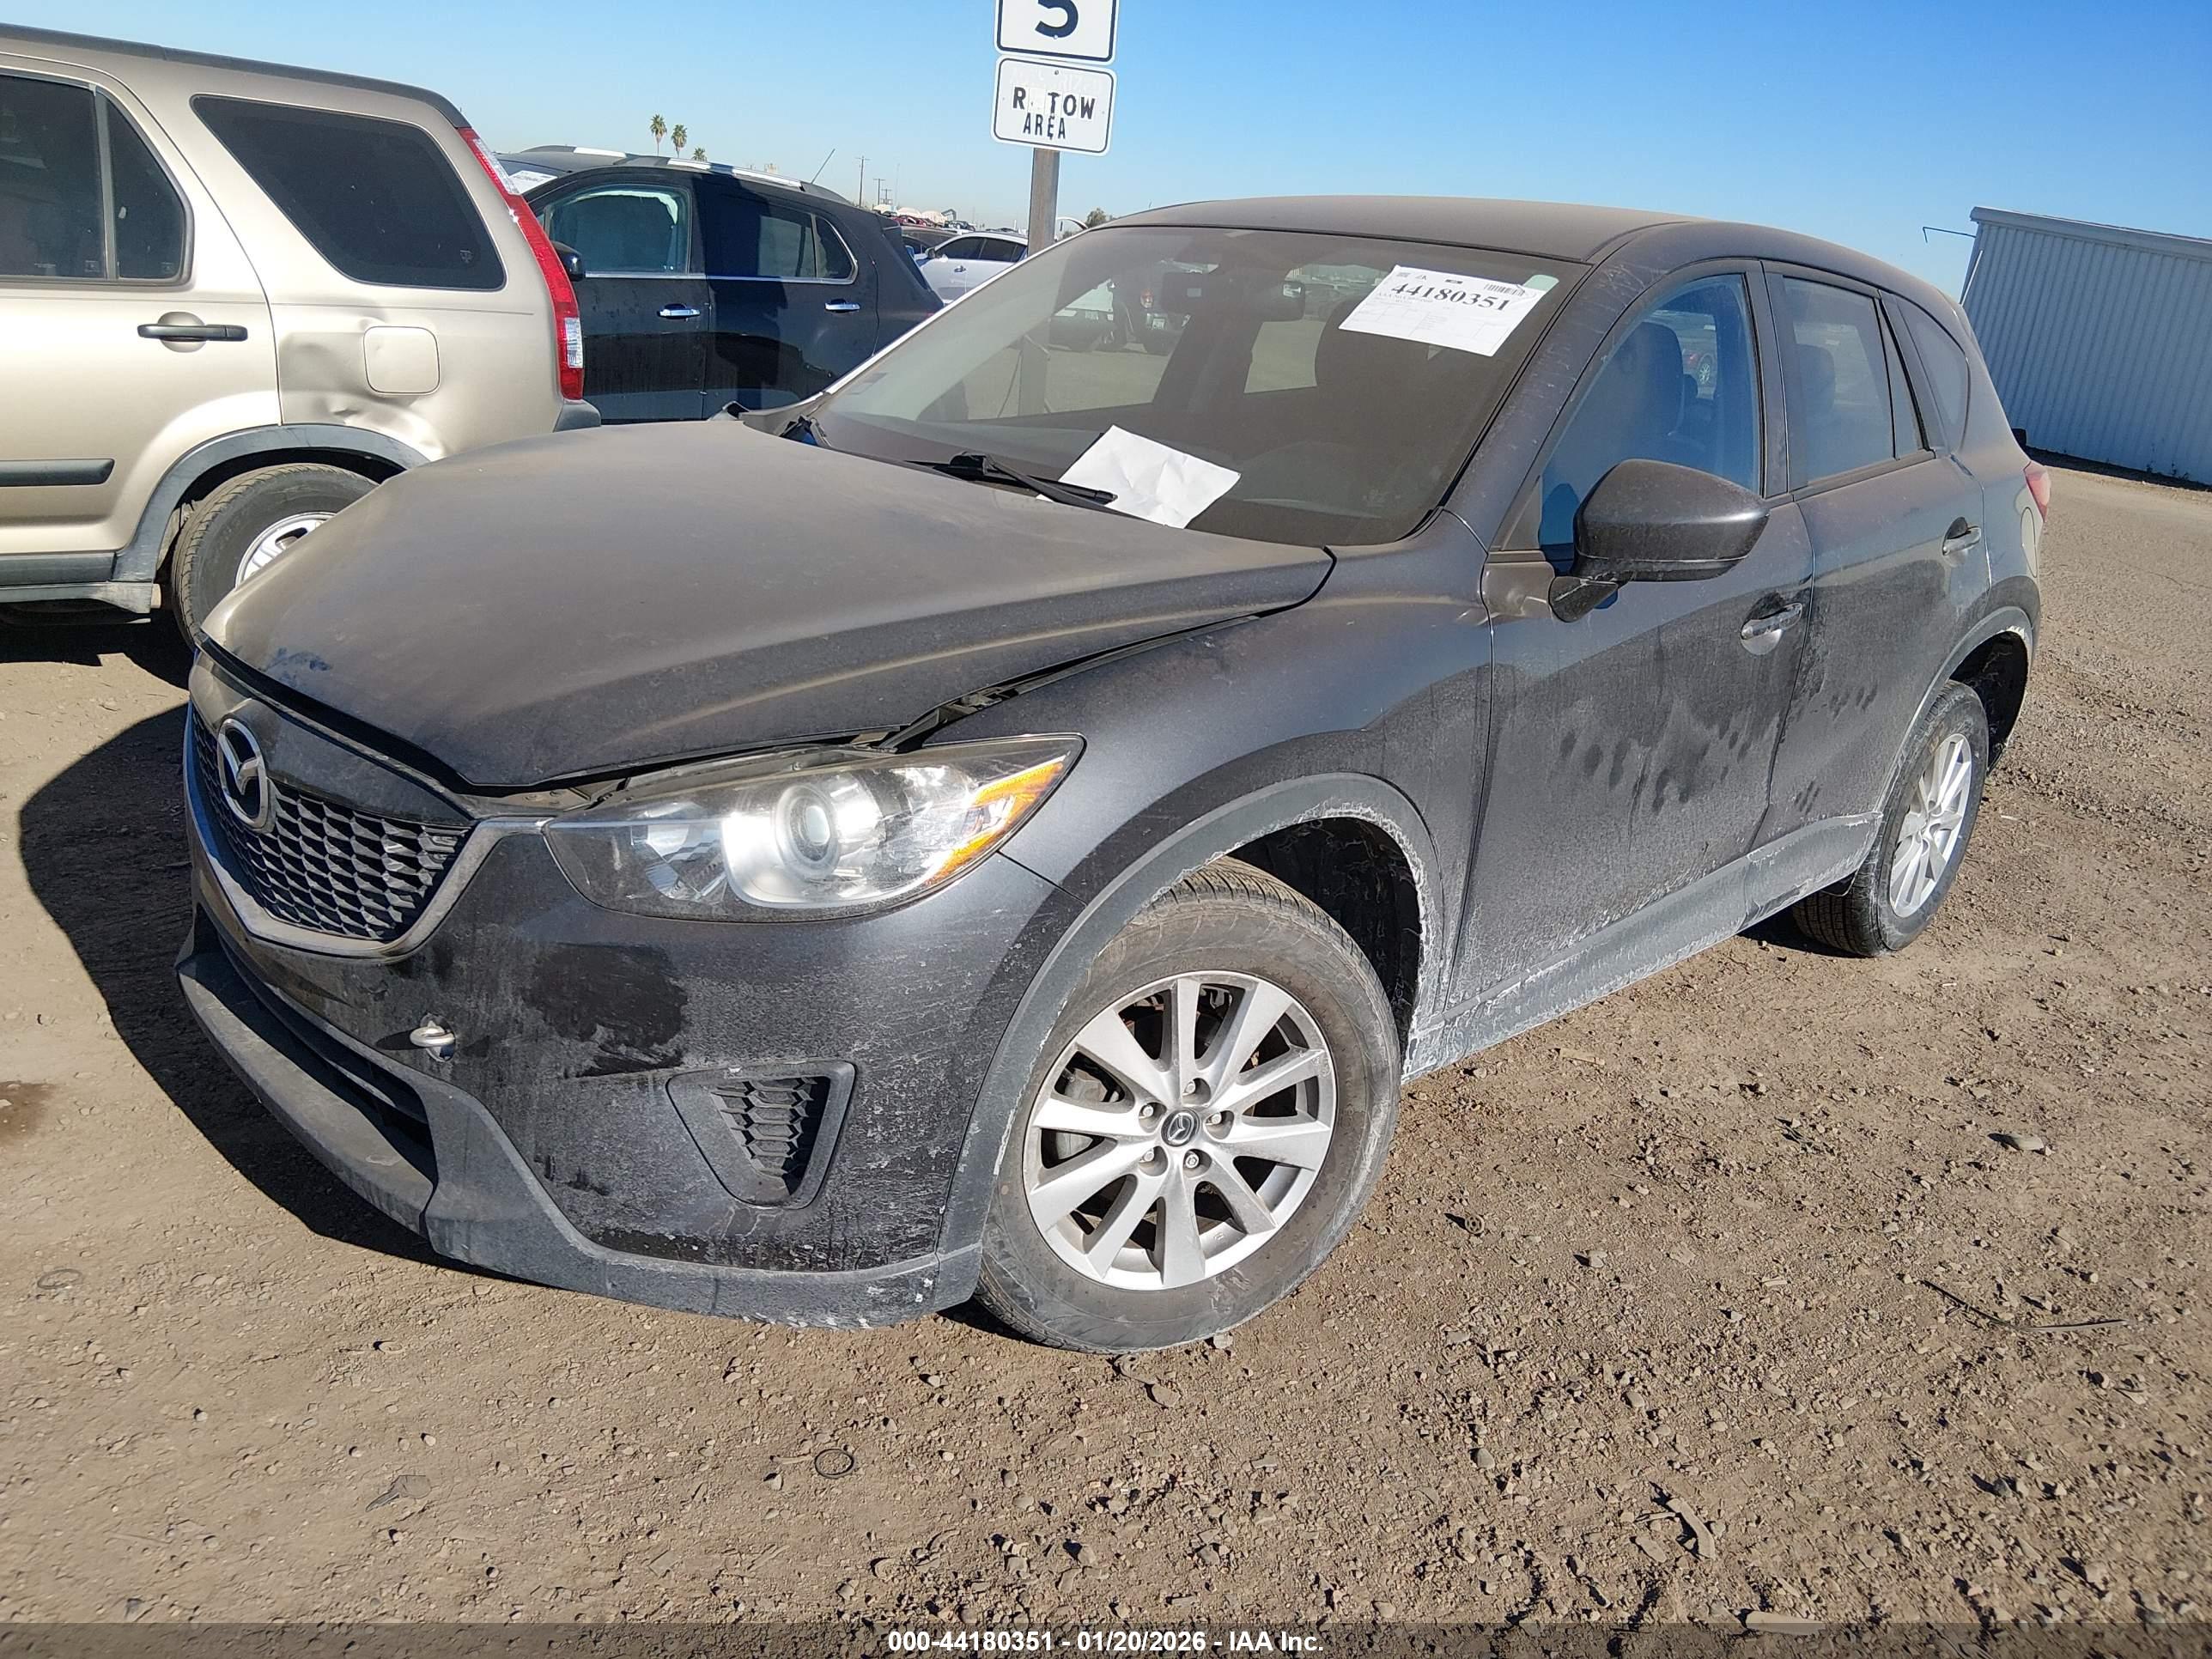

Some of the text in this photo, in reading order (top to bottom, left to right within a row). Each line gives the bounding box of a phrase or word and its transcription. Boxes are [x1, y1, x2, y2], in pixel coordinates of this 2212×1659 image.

[1048, 92, 1096, 119] TOW
[1023, 112, 1066, 140] AREA
[1390, 283, 1510, 312] 44180351
